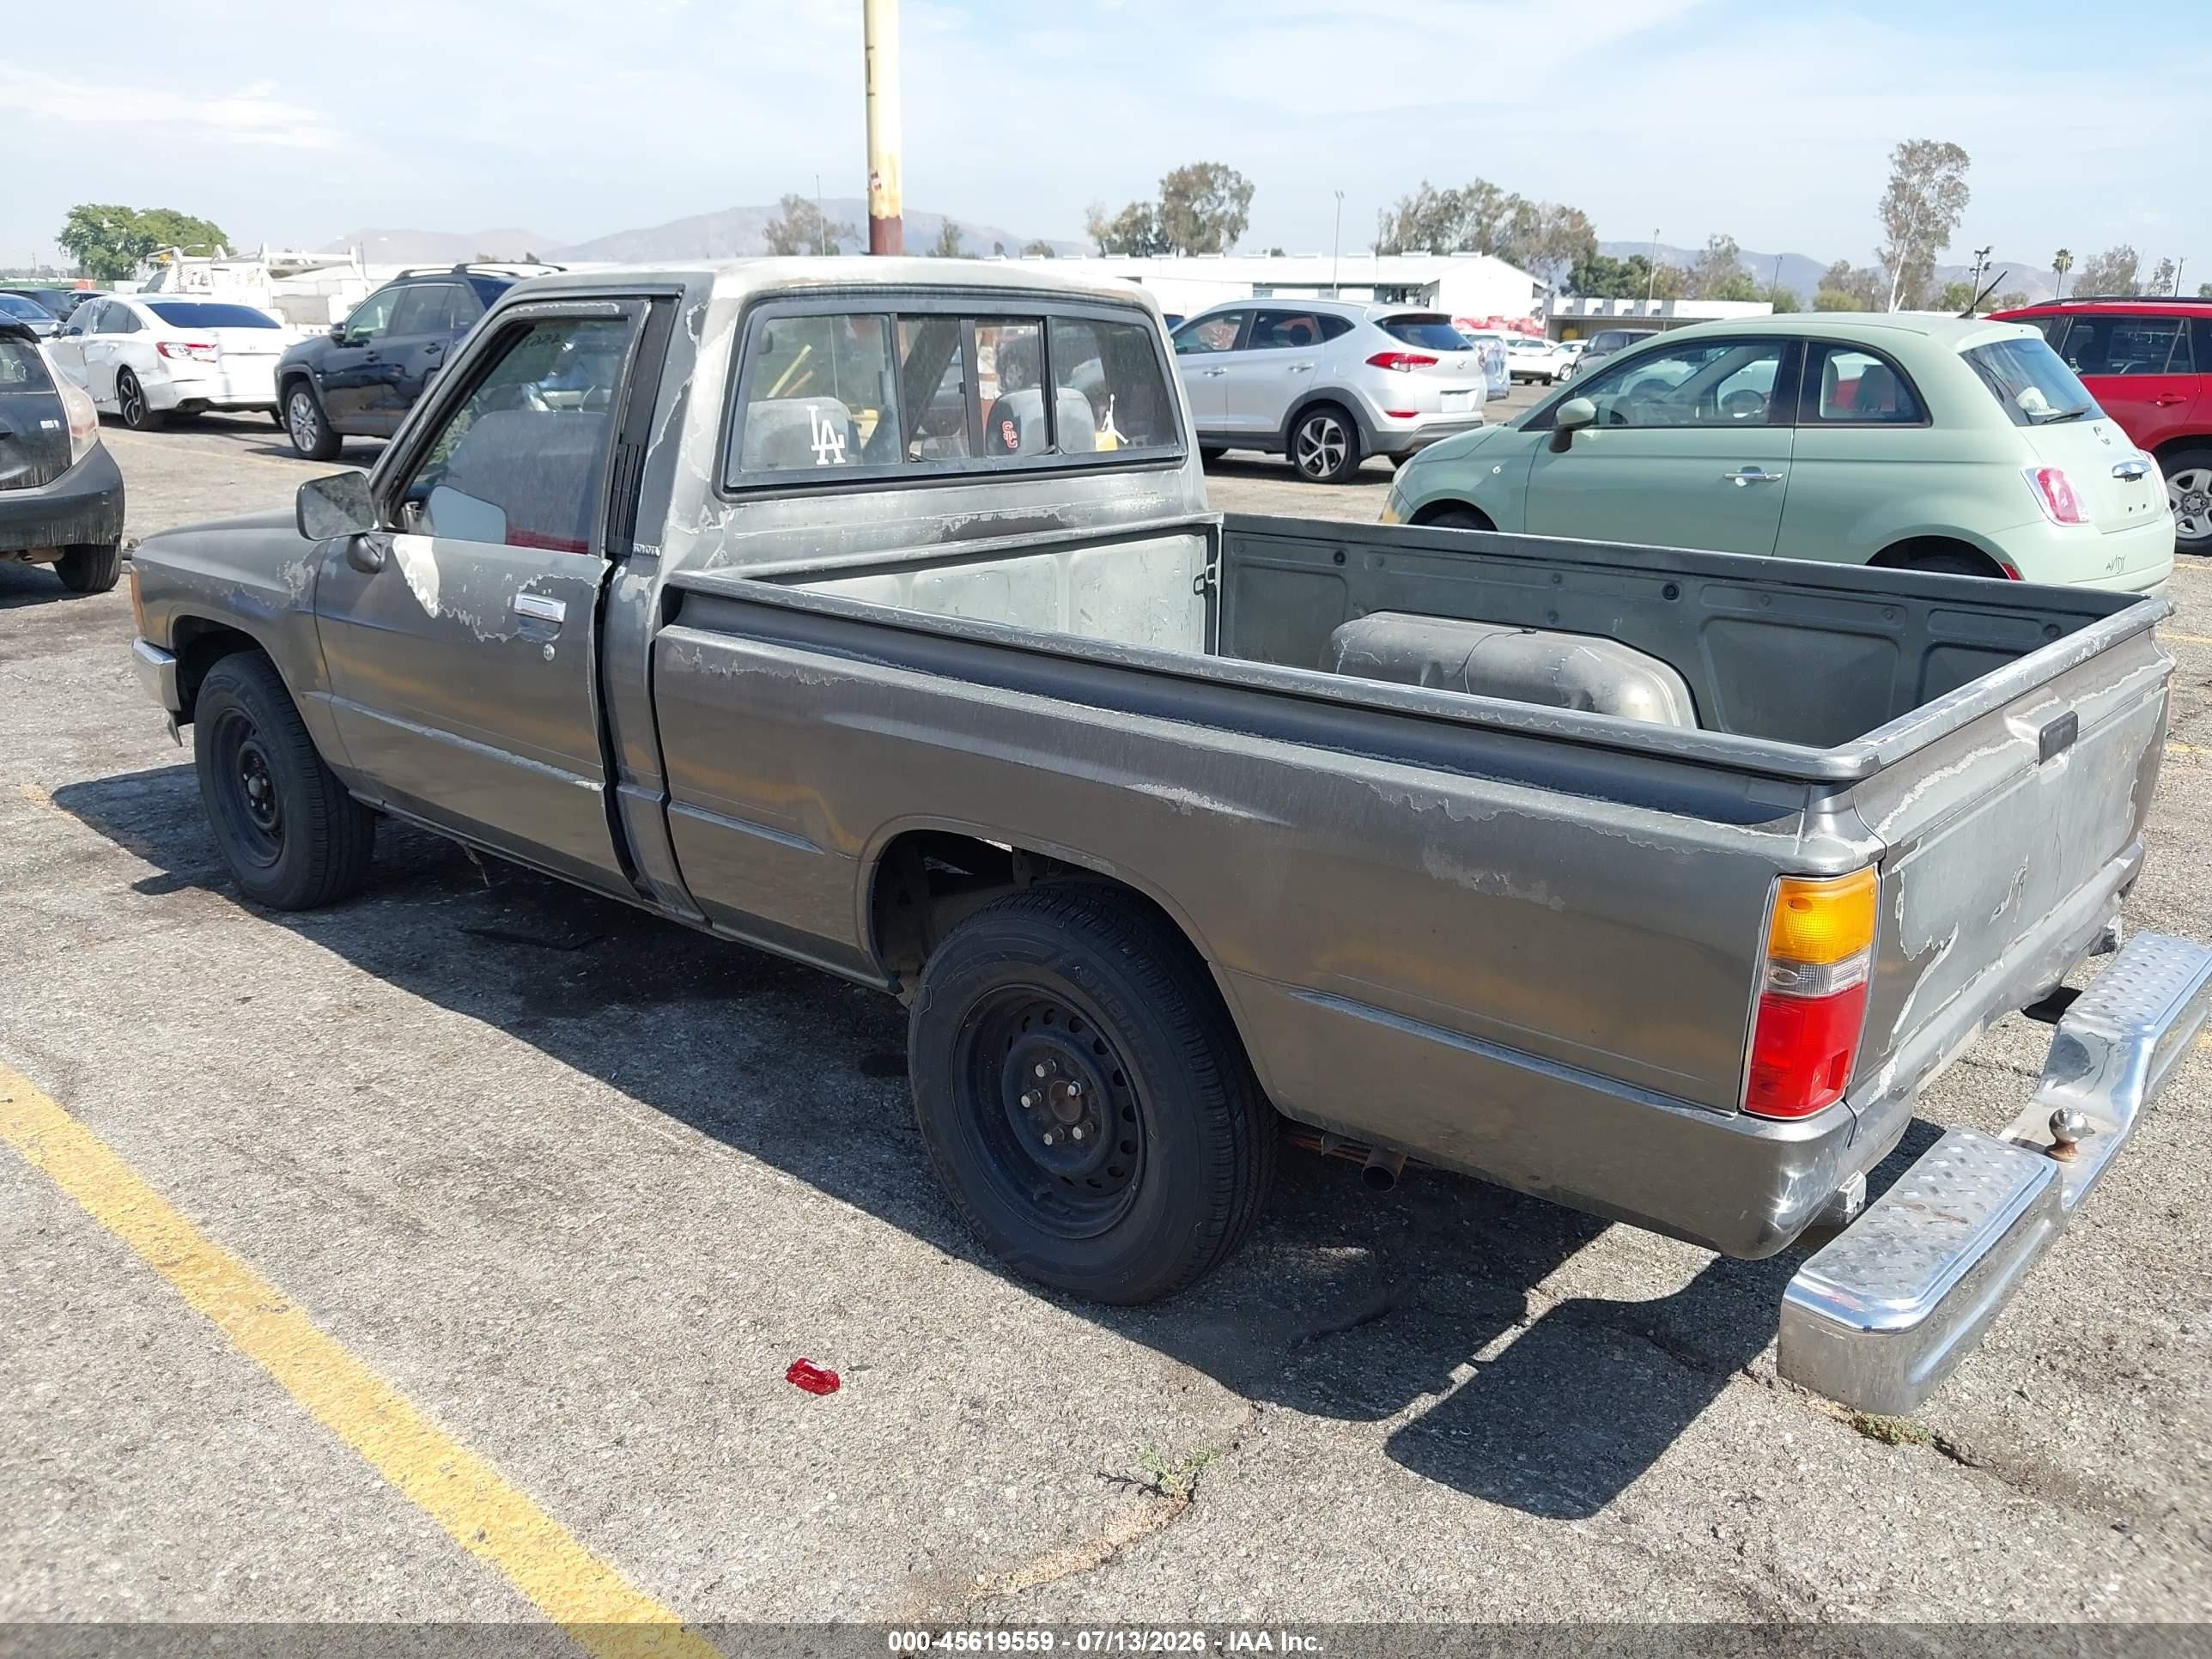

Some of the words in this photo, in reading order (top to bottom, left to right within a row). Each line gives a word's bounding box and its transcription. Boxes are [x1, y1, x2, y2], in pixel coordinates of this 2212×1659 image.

[805, 404, 846, 465] LA
[1001, 420, 1018, 449] SC
[633, 543, 662, 557] TOYOTA
